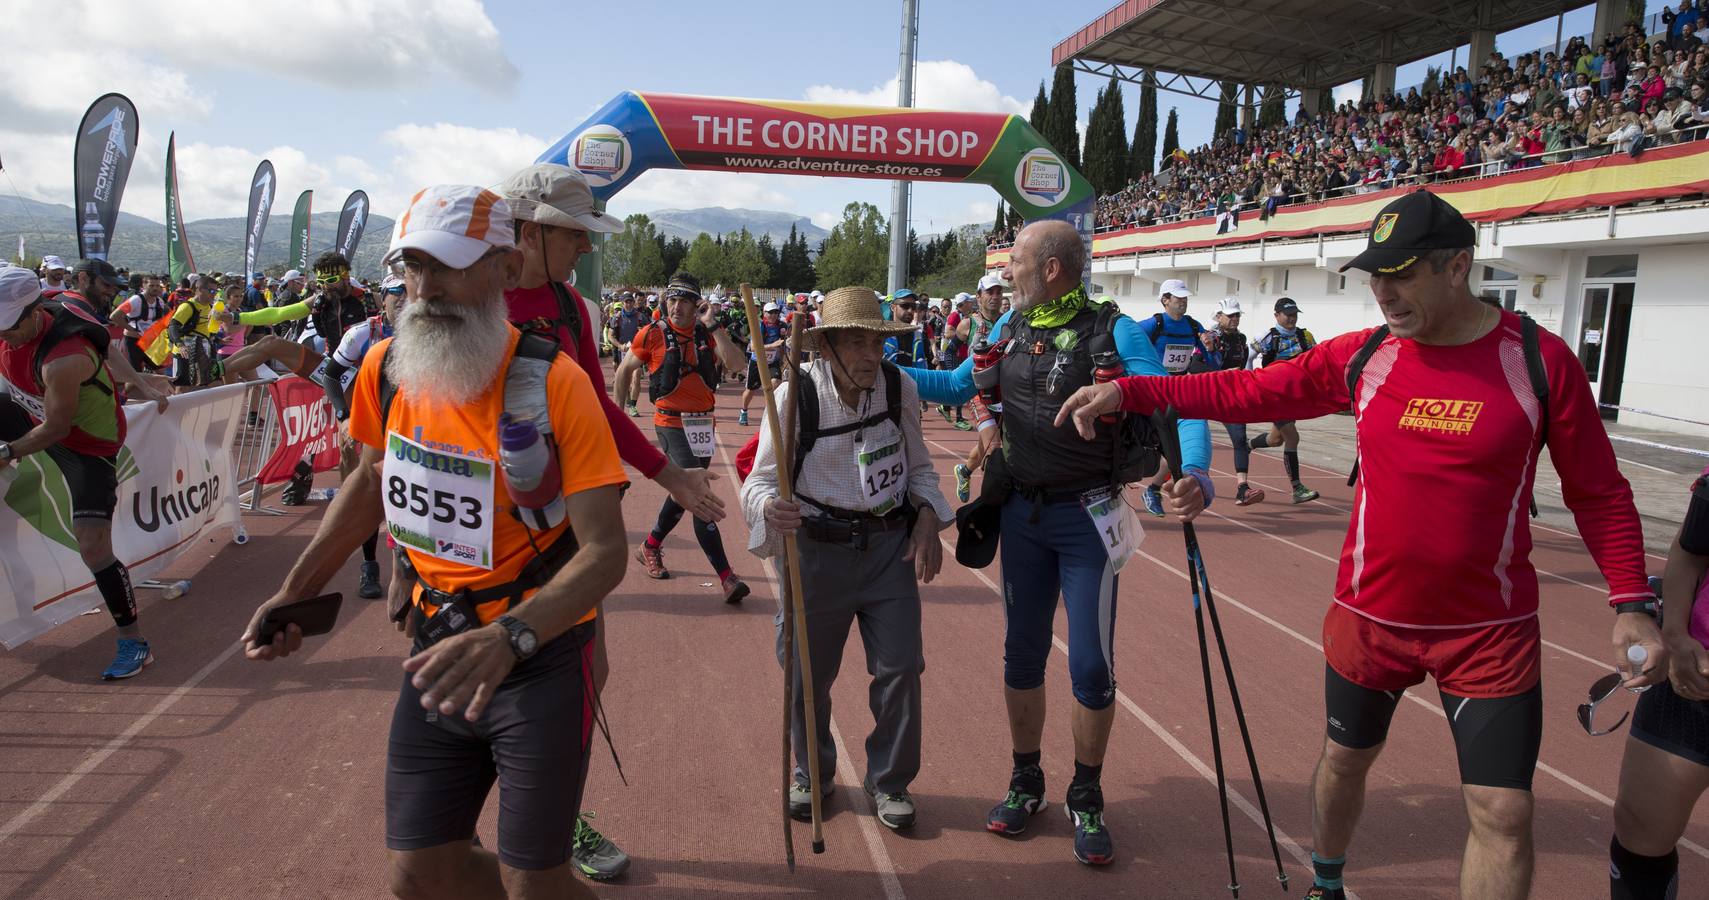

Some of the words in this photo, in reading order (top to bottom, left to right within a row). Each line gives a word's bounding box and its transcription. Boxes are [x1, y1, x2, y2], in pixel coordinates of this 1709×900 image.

[692, 115, 753, 146] THE
[762, 120, 888, 154] CORNER
[896, 128, 979, 158] SHOP
[94, 108, 126, 201] POWERADE
[584, 157, 606, 166] Shop
[585, 149, 615, 158] Corner
[725, 157, 942, 177] www.adventure-store.es
[1030, 180, 1050, 188] Shop
[299, 229, 308, 269] Unicaja
[1168, 354, 1187, 363] 343
[1407, 400, 1481, 420] HOLE!
[133, 459, 220, 532] Unicaja
[388, 475, 483, 530] 8553
[454, 544, 477, 554] INTER
[454, 549, 476, 560] SPORT
